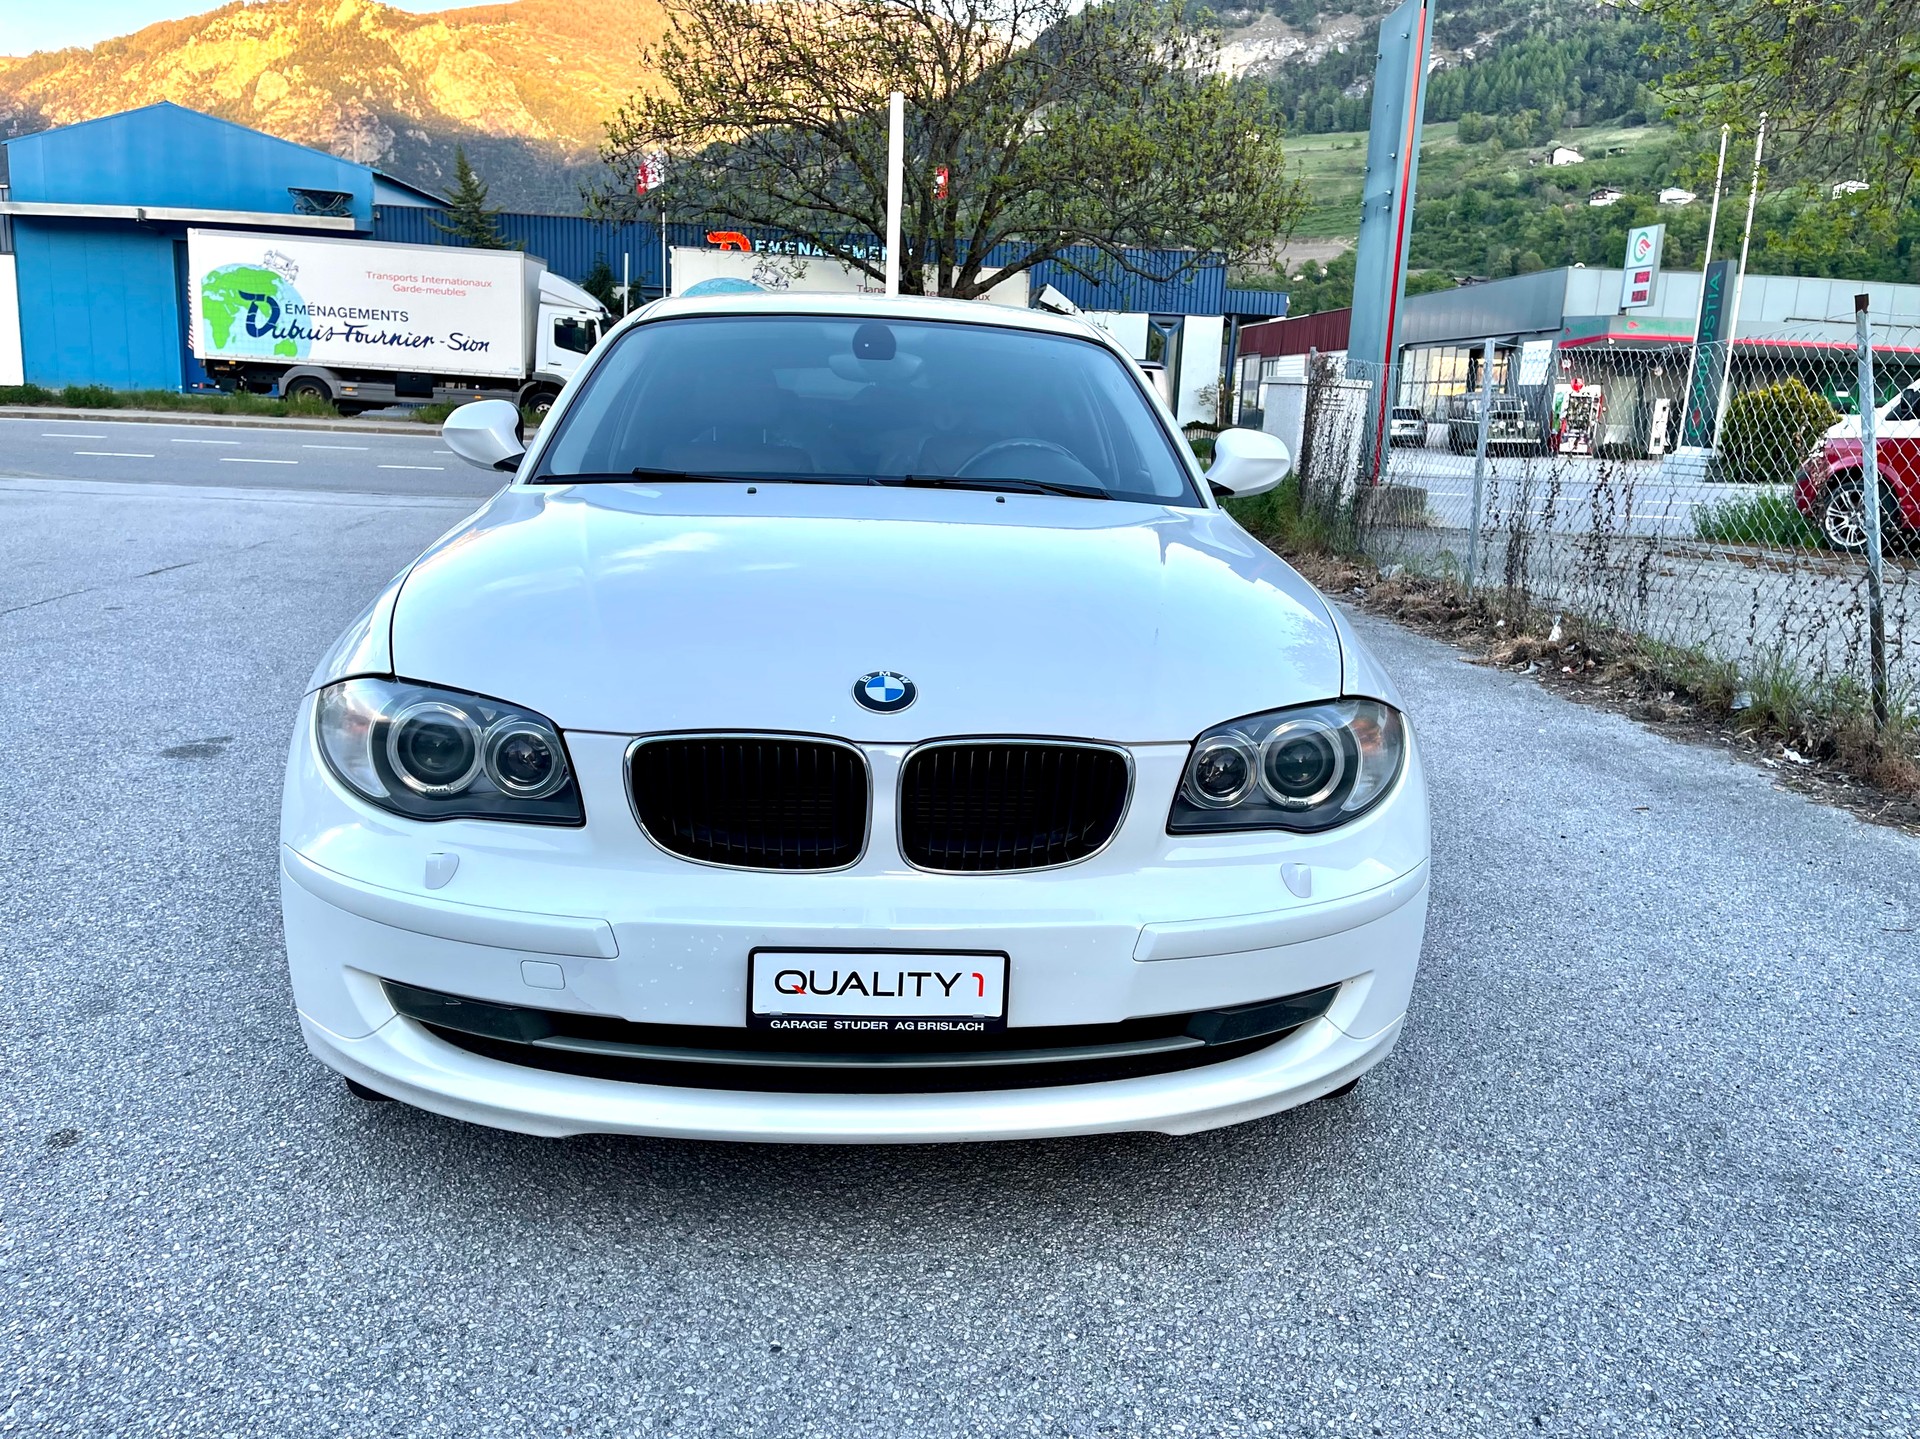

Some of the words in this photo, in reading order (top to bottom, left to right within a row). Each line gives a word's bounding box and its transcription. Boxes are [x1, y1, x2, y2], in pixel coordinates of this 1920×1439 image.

[366, 271, 418, 282] Transports
[421, 275, 492, 287] Internationaux
[393, 283, 466, 296] Garde-meubles
[447, 332, 490, 352] Sion
[859, 671, 911, 684] BMW
[774, 969, 962, 997] QUALITY
[972, 972, 985, 997] 1
[770, 1020, 827, 1030] GARAGE
[834, 1020, 888, 1030] STUDER
[895, 1021, 914, 1031] AG
[918, 1021, 984, 1031] BRISLACH
